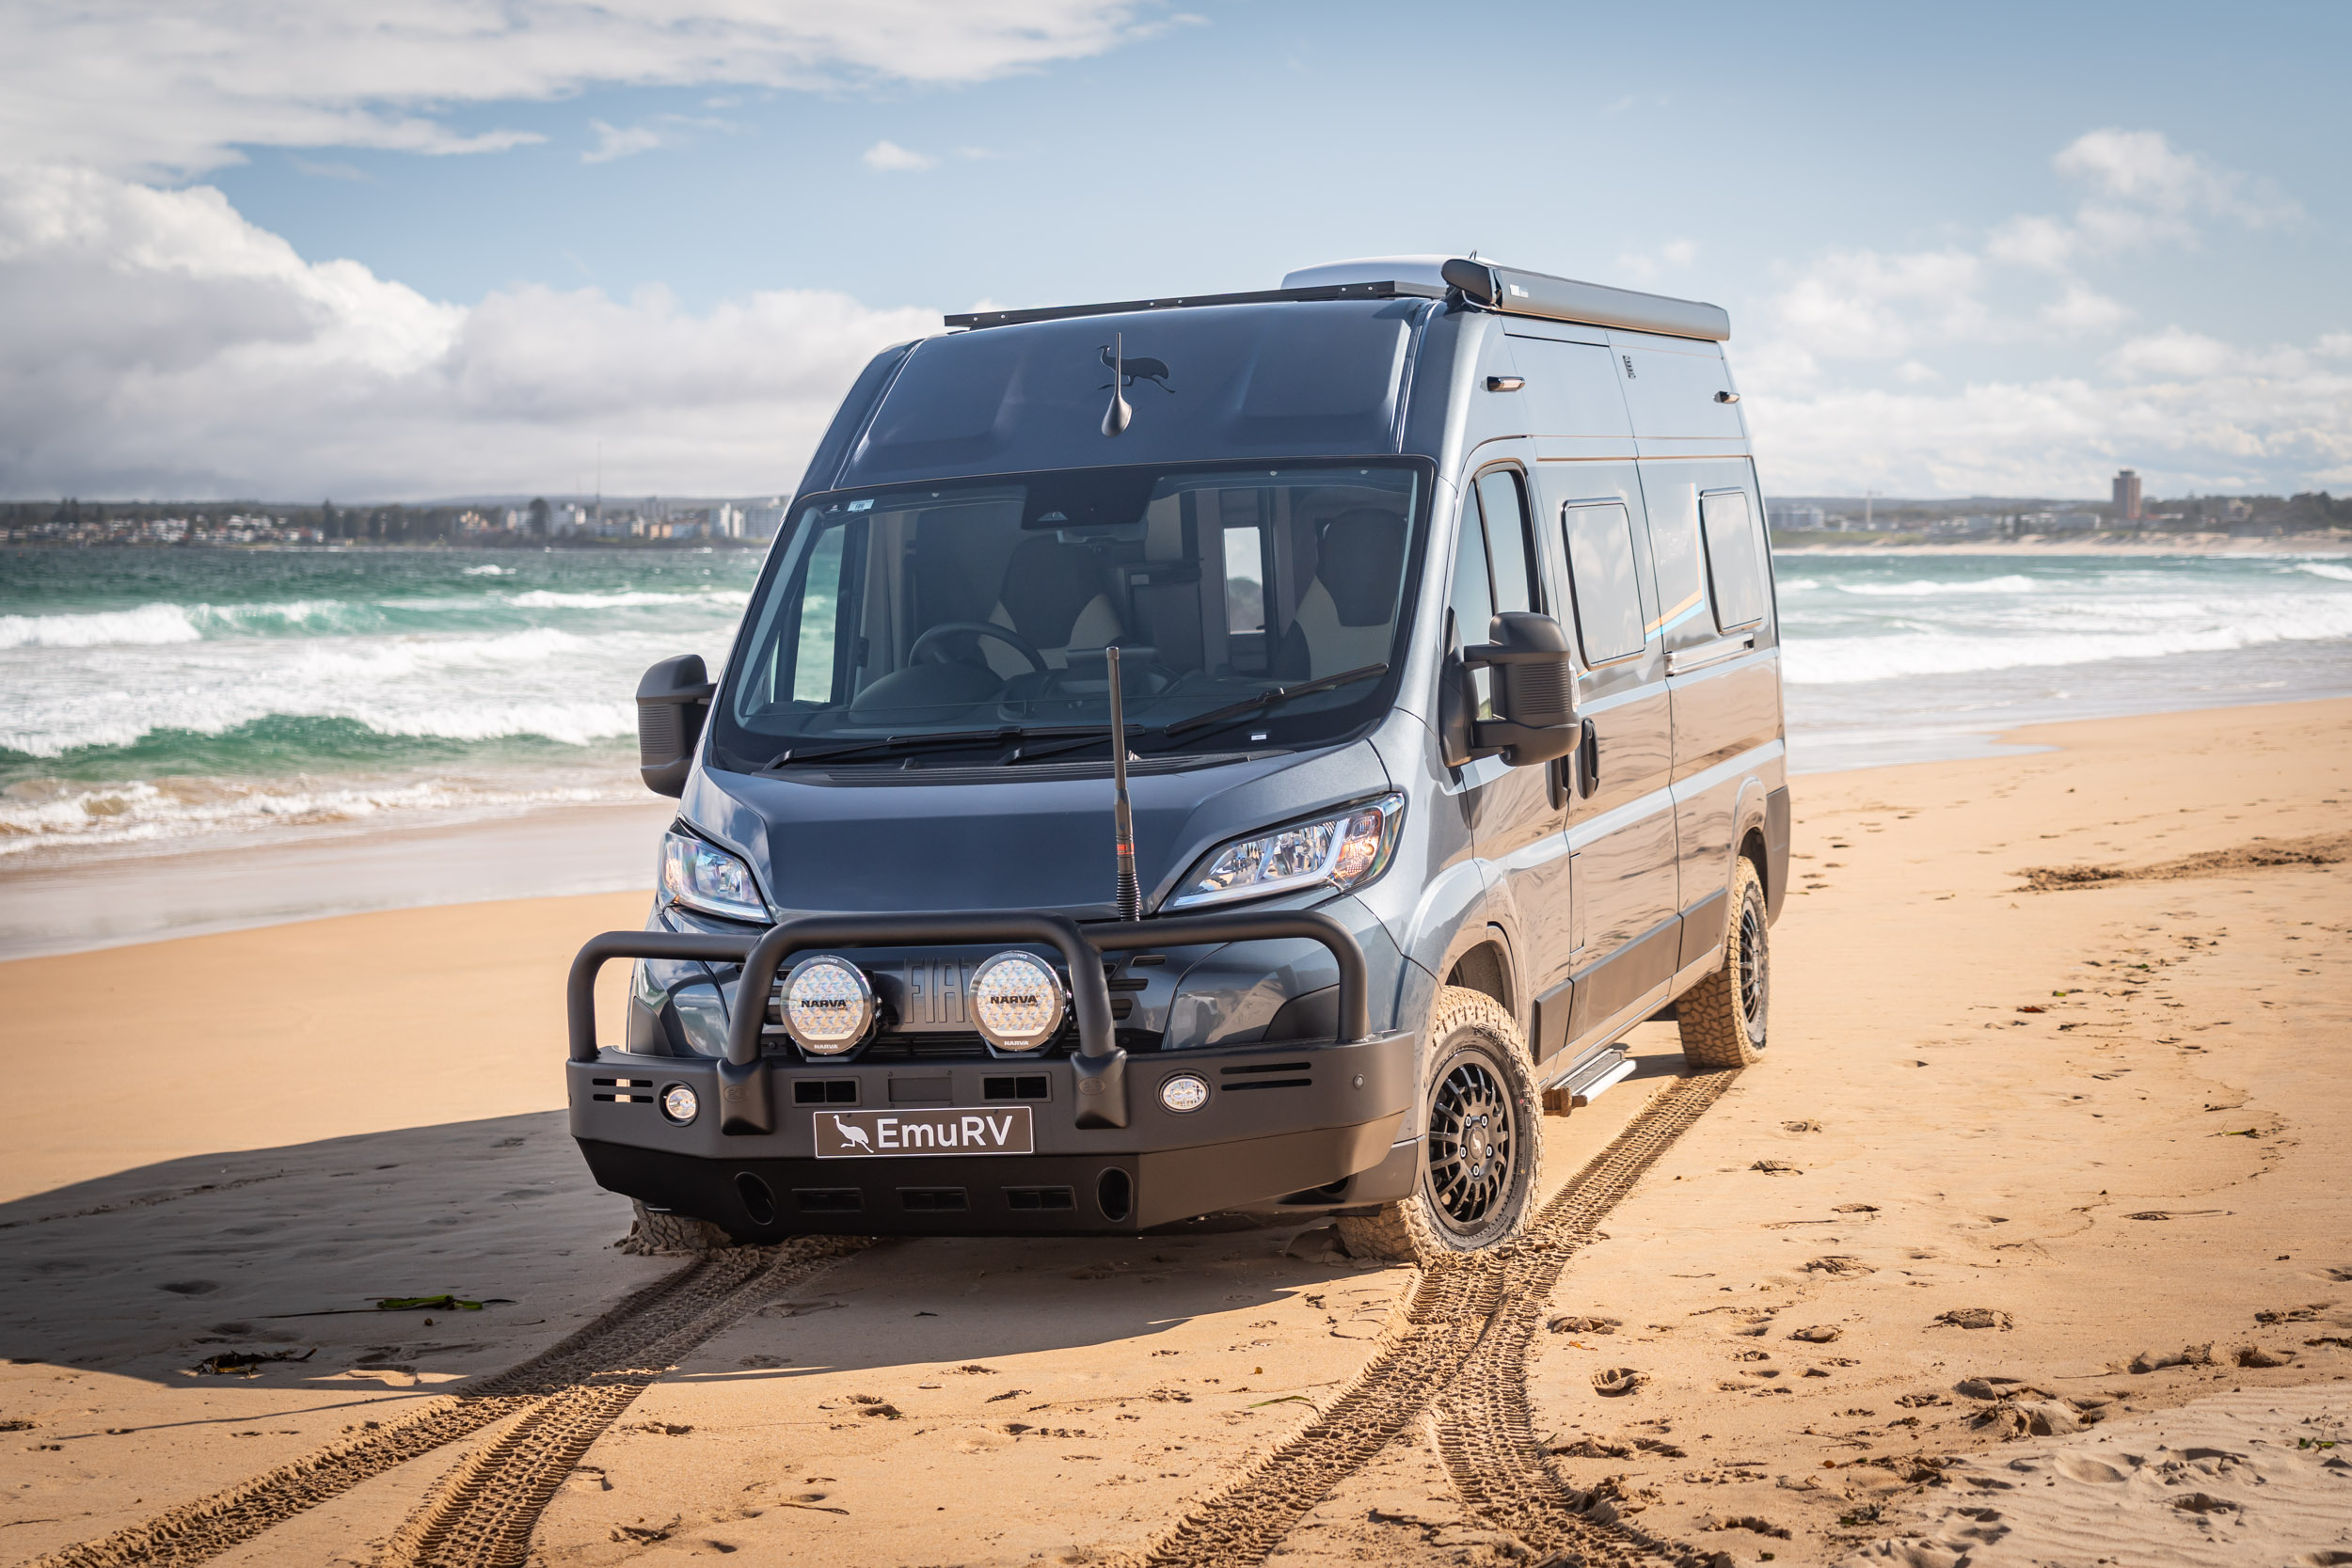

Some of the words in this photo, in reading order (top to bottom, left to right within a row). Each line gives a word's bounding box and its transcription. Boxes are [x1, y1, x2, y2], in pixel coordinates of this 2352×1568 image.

[801, 999, 847, 1008] NARVA
[990, 995, 1038, 1005] NARVA
[877, 1116, 1013, 1148] EmuRV
